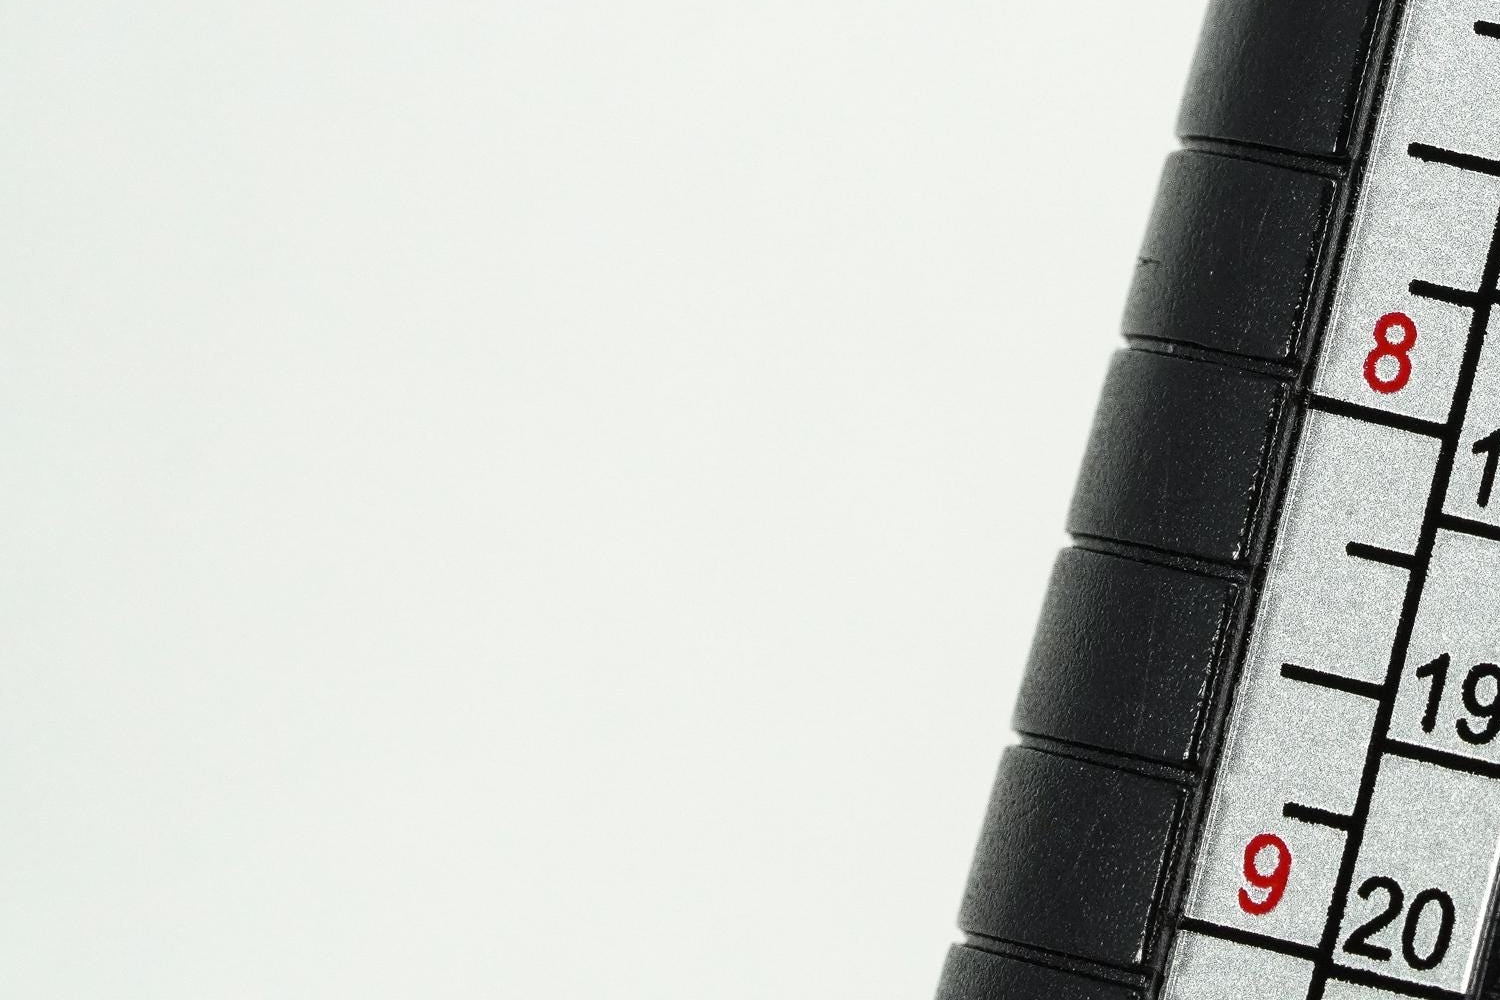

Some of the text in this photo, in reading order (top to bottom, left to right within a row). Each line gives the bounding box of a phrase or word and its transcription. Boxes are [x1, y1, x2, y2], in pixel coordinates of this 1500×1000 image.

[1362, 311, 1418, 395] 8
[1237, 833, 1292, 917] 9
[1341, 875, 1457, 972] 20
